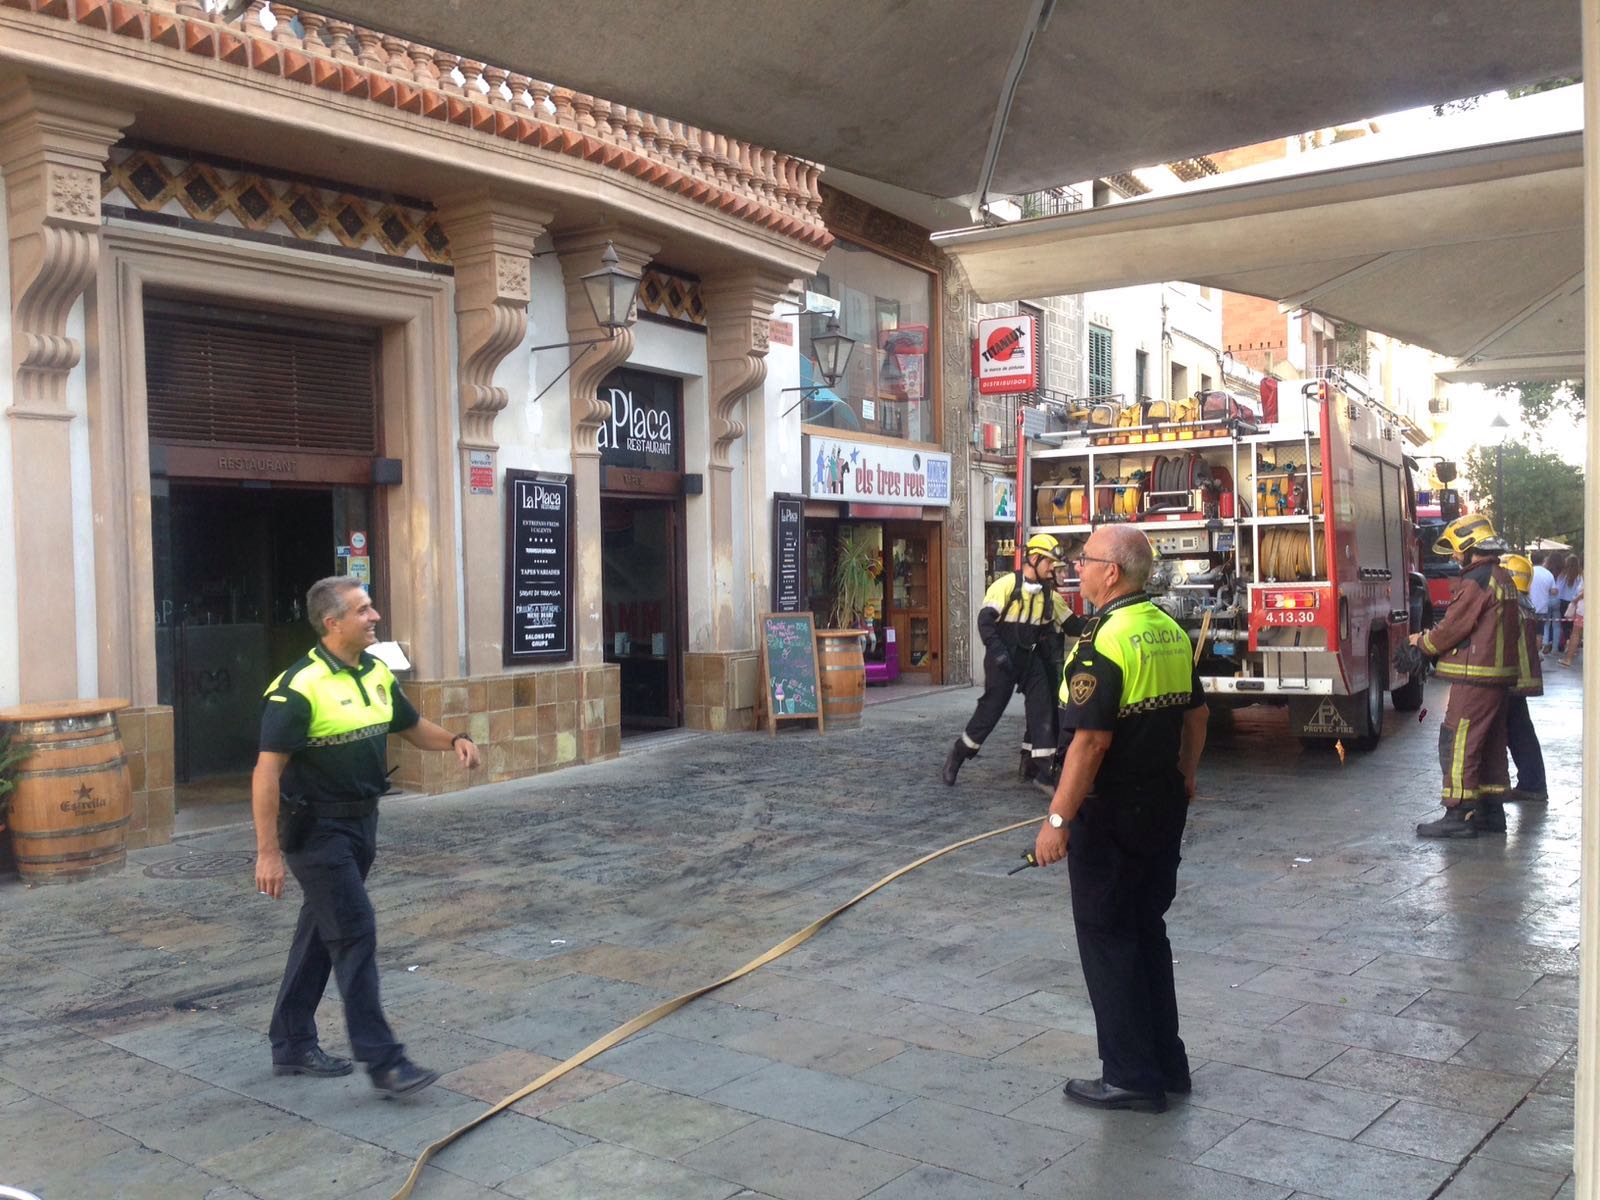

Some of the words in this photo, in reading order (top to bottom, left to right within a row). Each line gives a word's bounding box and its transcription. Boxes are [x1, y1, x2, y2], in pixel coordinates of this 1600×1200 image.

[982, 326, 1025, 362] TITANLUX
[983, 379, 1026, 388] DISTRIBUIDOR
[627, 438, 671, 455] RESTAURANT
[218, 456, 296, 474] RESTAURANT
[855, 458, 874, 494] els
[876, 463, 901, 496] tres
[903, 472, 925, 497] reis
[522, 485, 533, 508] La
[1265, 611, 1315, 623] 4.13.30
[1129, 629, 1184, 650] POLICIA
[1303, 725, 1354, 733] PROTEC-FIRE
[60, 797, 106, 812] Estrella
